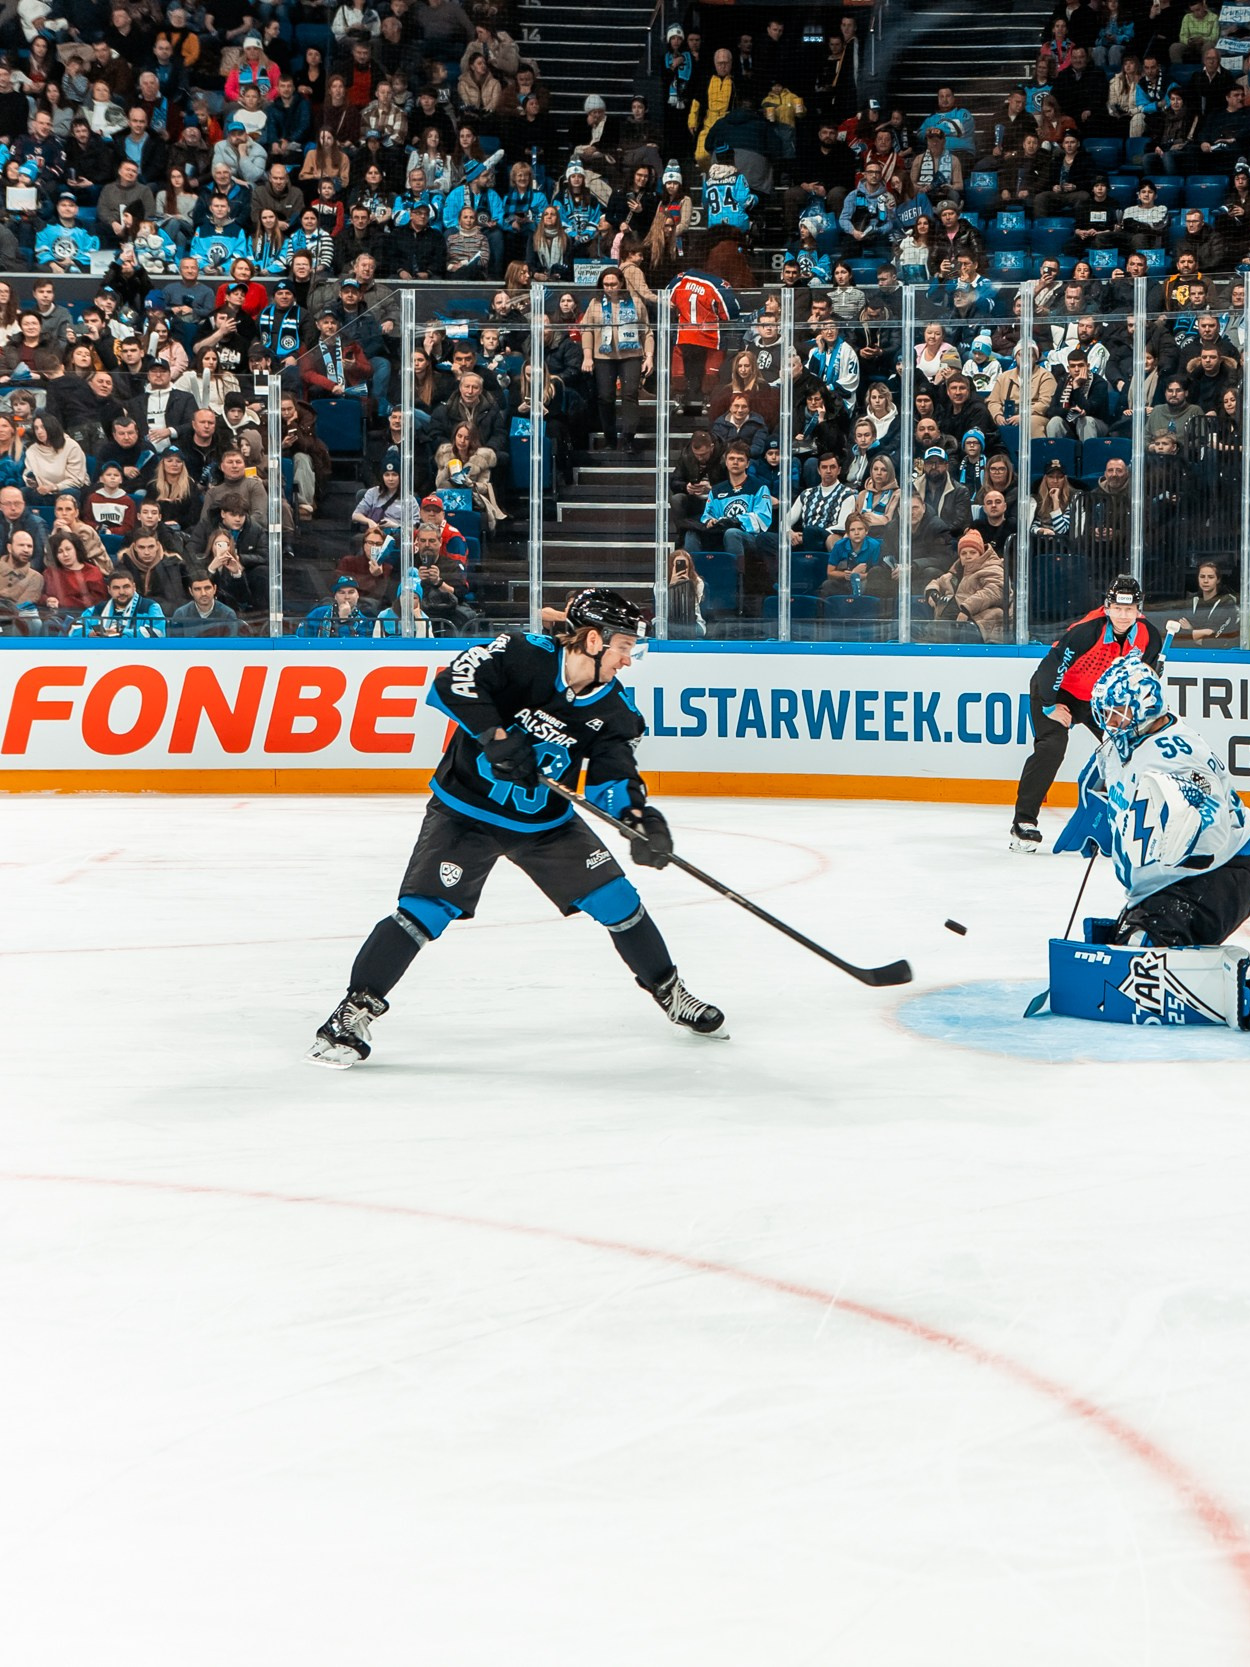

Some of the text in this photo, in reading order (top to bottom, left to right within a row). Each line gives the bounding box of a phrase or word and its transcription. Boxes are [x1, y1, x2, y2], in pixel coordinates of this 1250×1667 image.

[522, 28, 541, 42] 14
[1024, 65, 1036, 77] 1
[690, 210, 701, 226] 9
[772, 254, 784, 269] 8
[685, 282, 705, 296] КОНЬ
[688, 293, 698, 324] 1
[2, 665, 459, 756] FONBE
[534, 709, 567, 730] FONBET
[625, 686, 1036, 746] LLSTARWEEK.CO
[1154, 735, 1193, 760] 59
